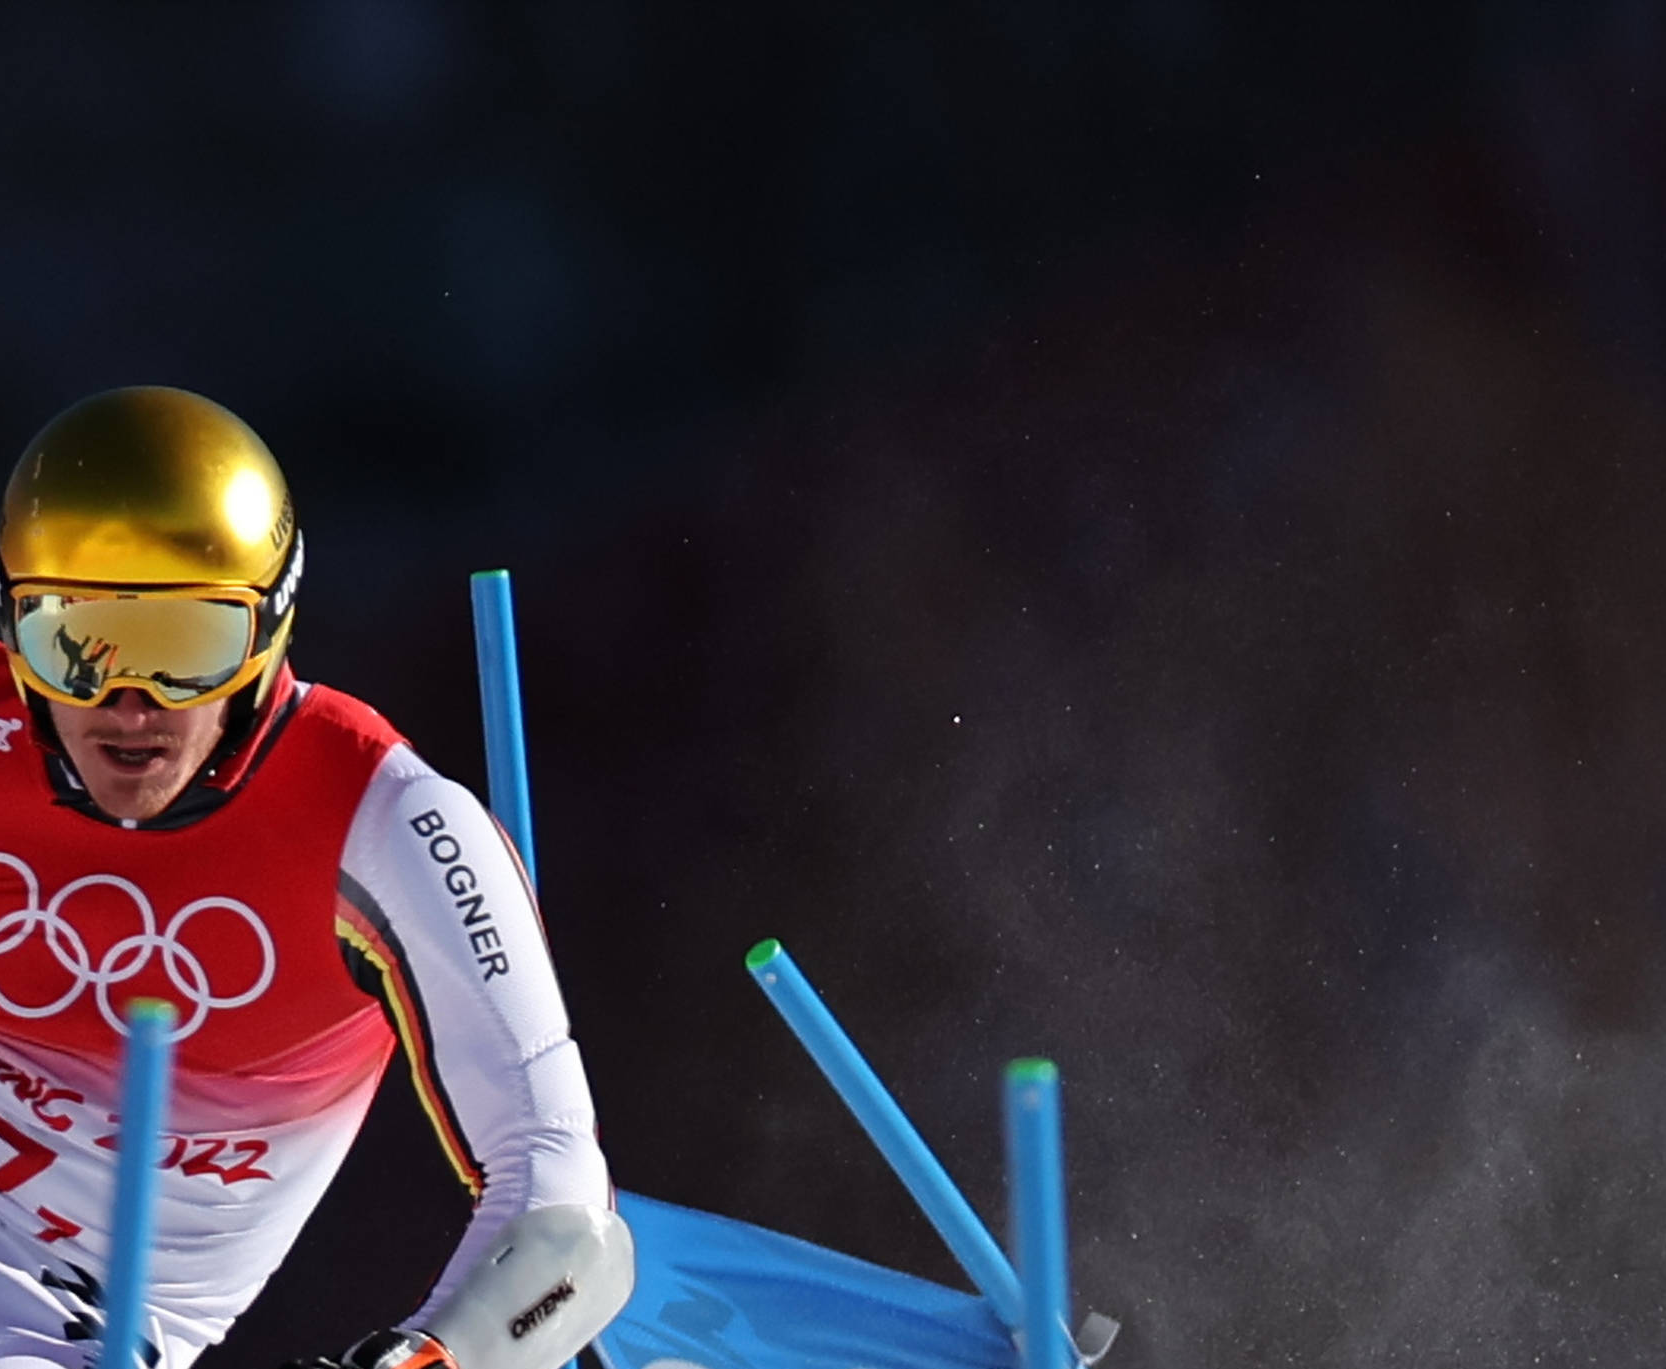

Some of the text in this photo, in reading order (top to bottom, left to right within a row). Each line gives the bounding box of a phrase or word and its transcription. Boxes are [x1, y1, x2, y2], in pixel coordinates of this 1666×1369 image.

[409, 808, 510, 983] BOGNER
[36, 1206, 83, 1243] 7
[510, 1277, 576, 1340] ORTEMA
